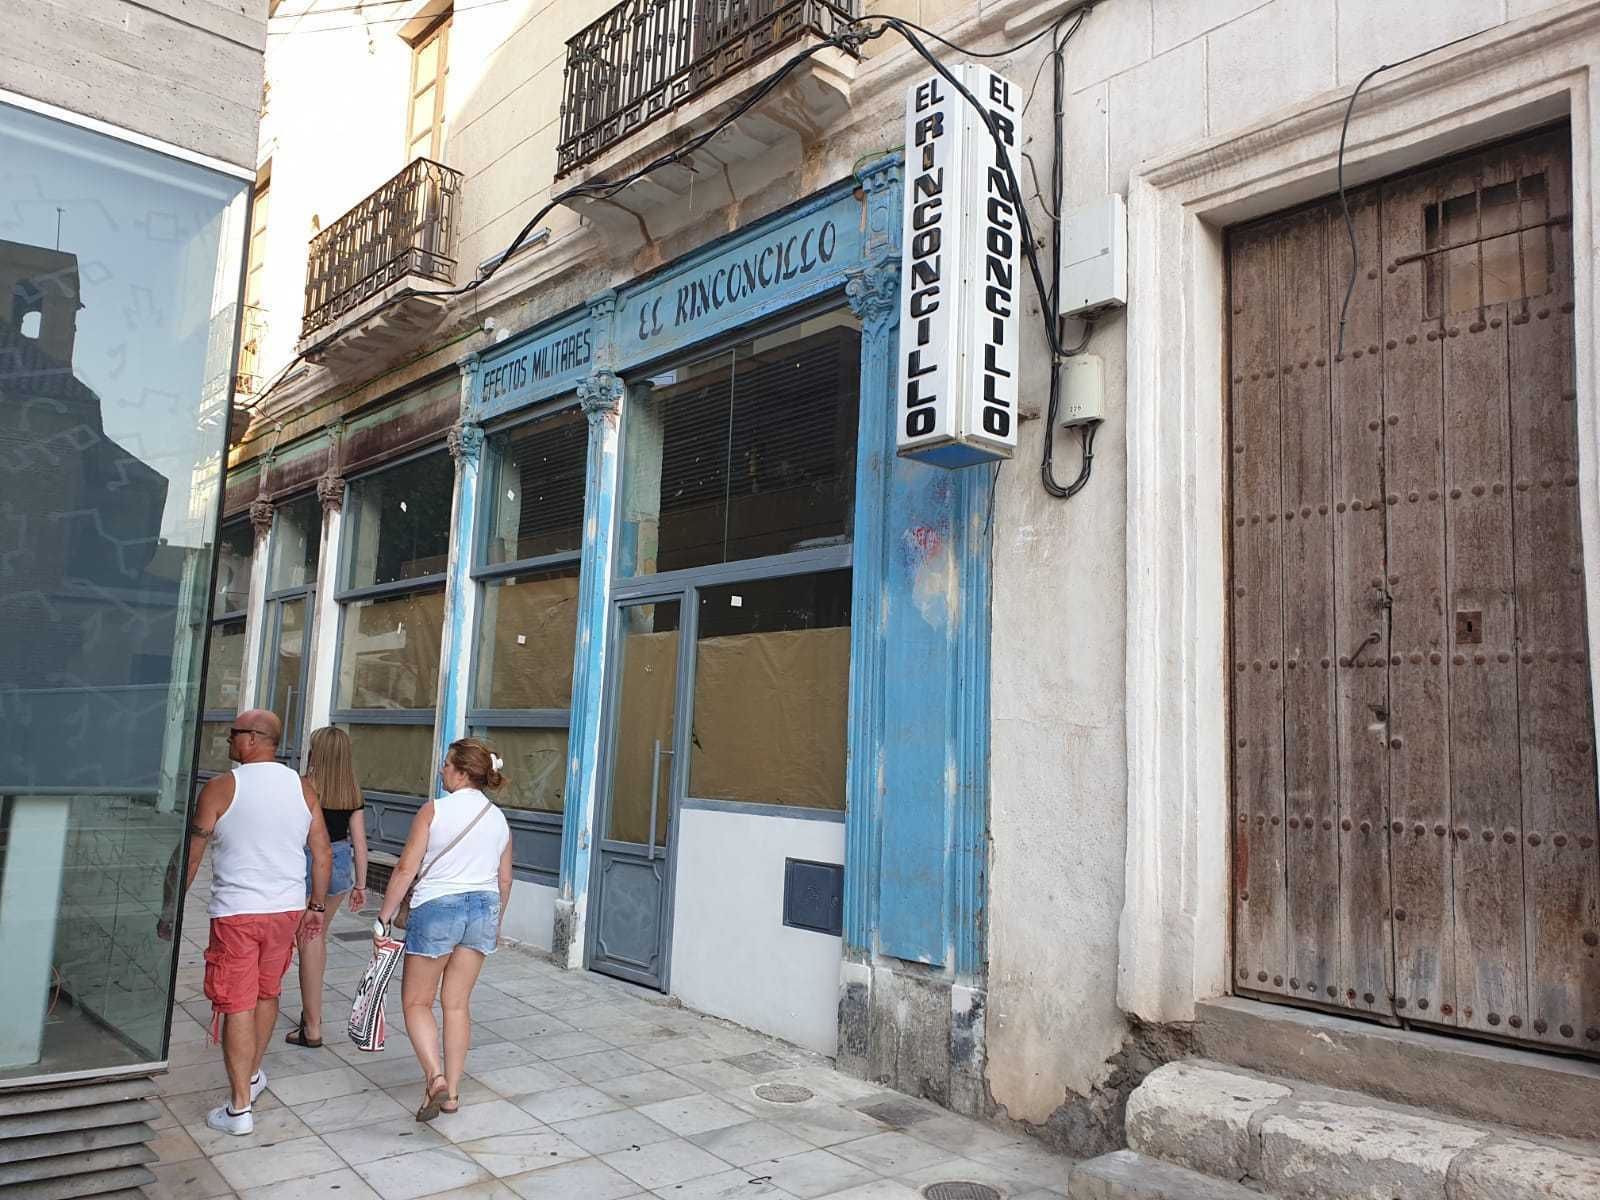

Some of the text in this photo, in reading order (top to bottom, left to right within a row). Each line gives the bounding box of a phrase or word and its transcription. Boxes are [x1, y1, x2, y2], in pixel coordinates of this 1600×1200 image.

[989, 74, 1015, 112] EL
[638, 220, 836, 341] EL RINCONCILLO
[906, 78, 944, 437] EL RINCONCILLO
[482, 327, 592, 403] EFECTOS MILITARES
